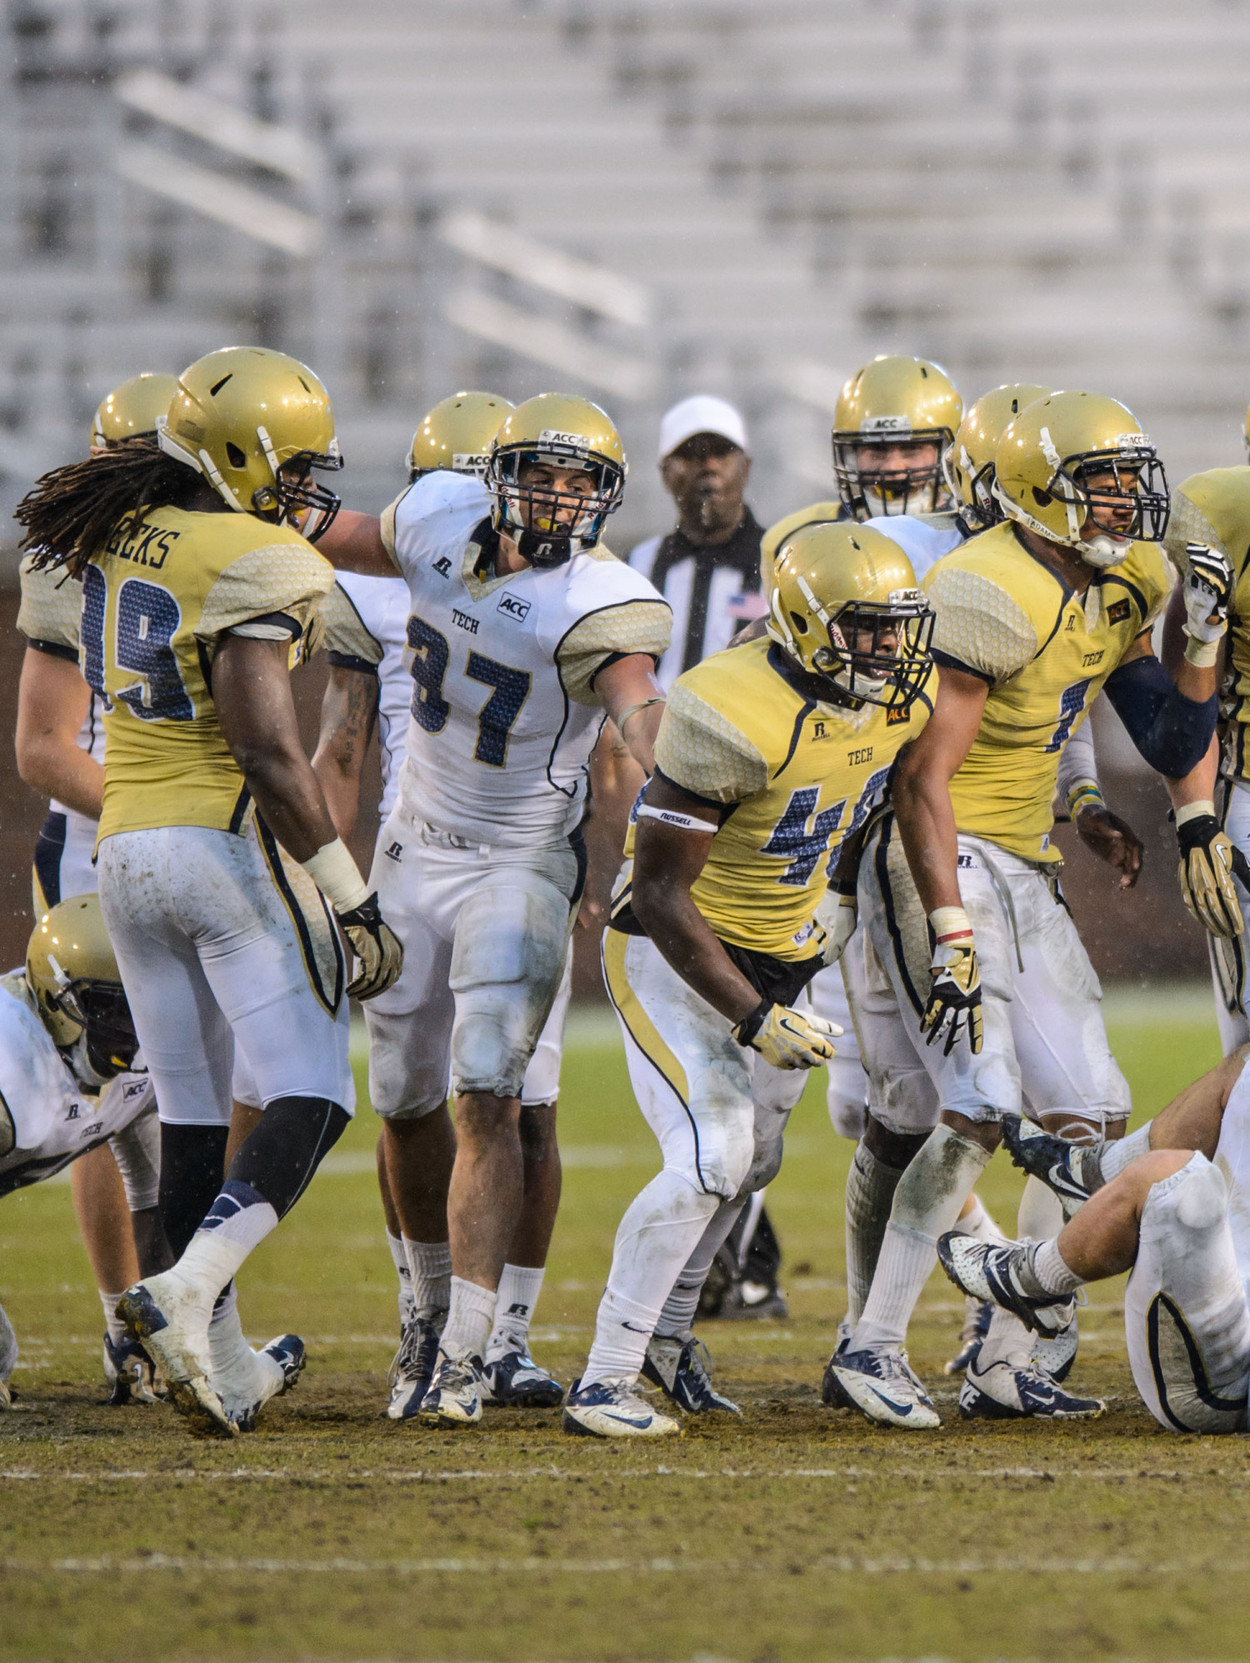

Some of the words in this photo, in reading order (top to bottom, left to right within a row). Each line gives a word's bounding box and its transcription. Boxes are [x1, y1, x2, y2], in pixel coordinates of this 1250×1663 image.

[874, 419, 897, 428] ACC
[551, 433, 575, 444] ACC
[106, 516, 180, 570] EEKS
[436, 556, 453, 571] R
[901, 591, 918, 600] ACC
[500, 597, 529, 618] ACC
[452, 608, 480, 635] TECH
[1082, 650, 1105, 668] TECH
[888, 708, 908, 721] ACC
[1043, 677, 1094, 753] 1
[814, 722, 825, 736] R
[847, 747, 873, 767] TECH
[660, 812, 692, 826] RUSSELL
[389, 841, 403, 857] R
[124, 1081, 148, 1099] ACC
